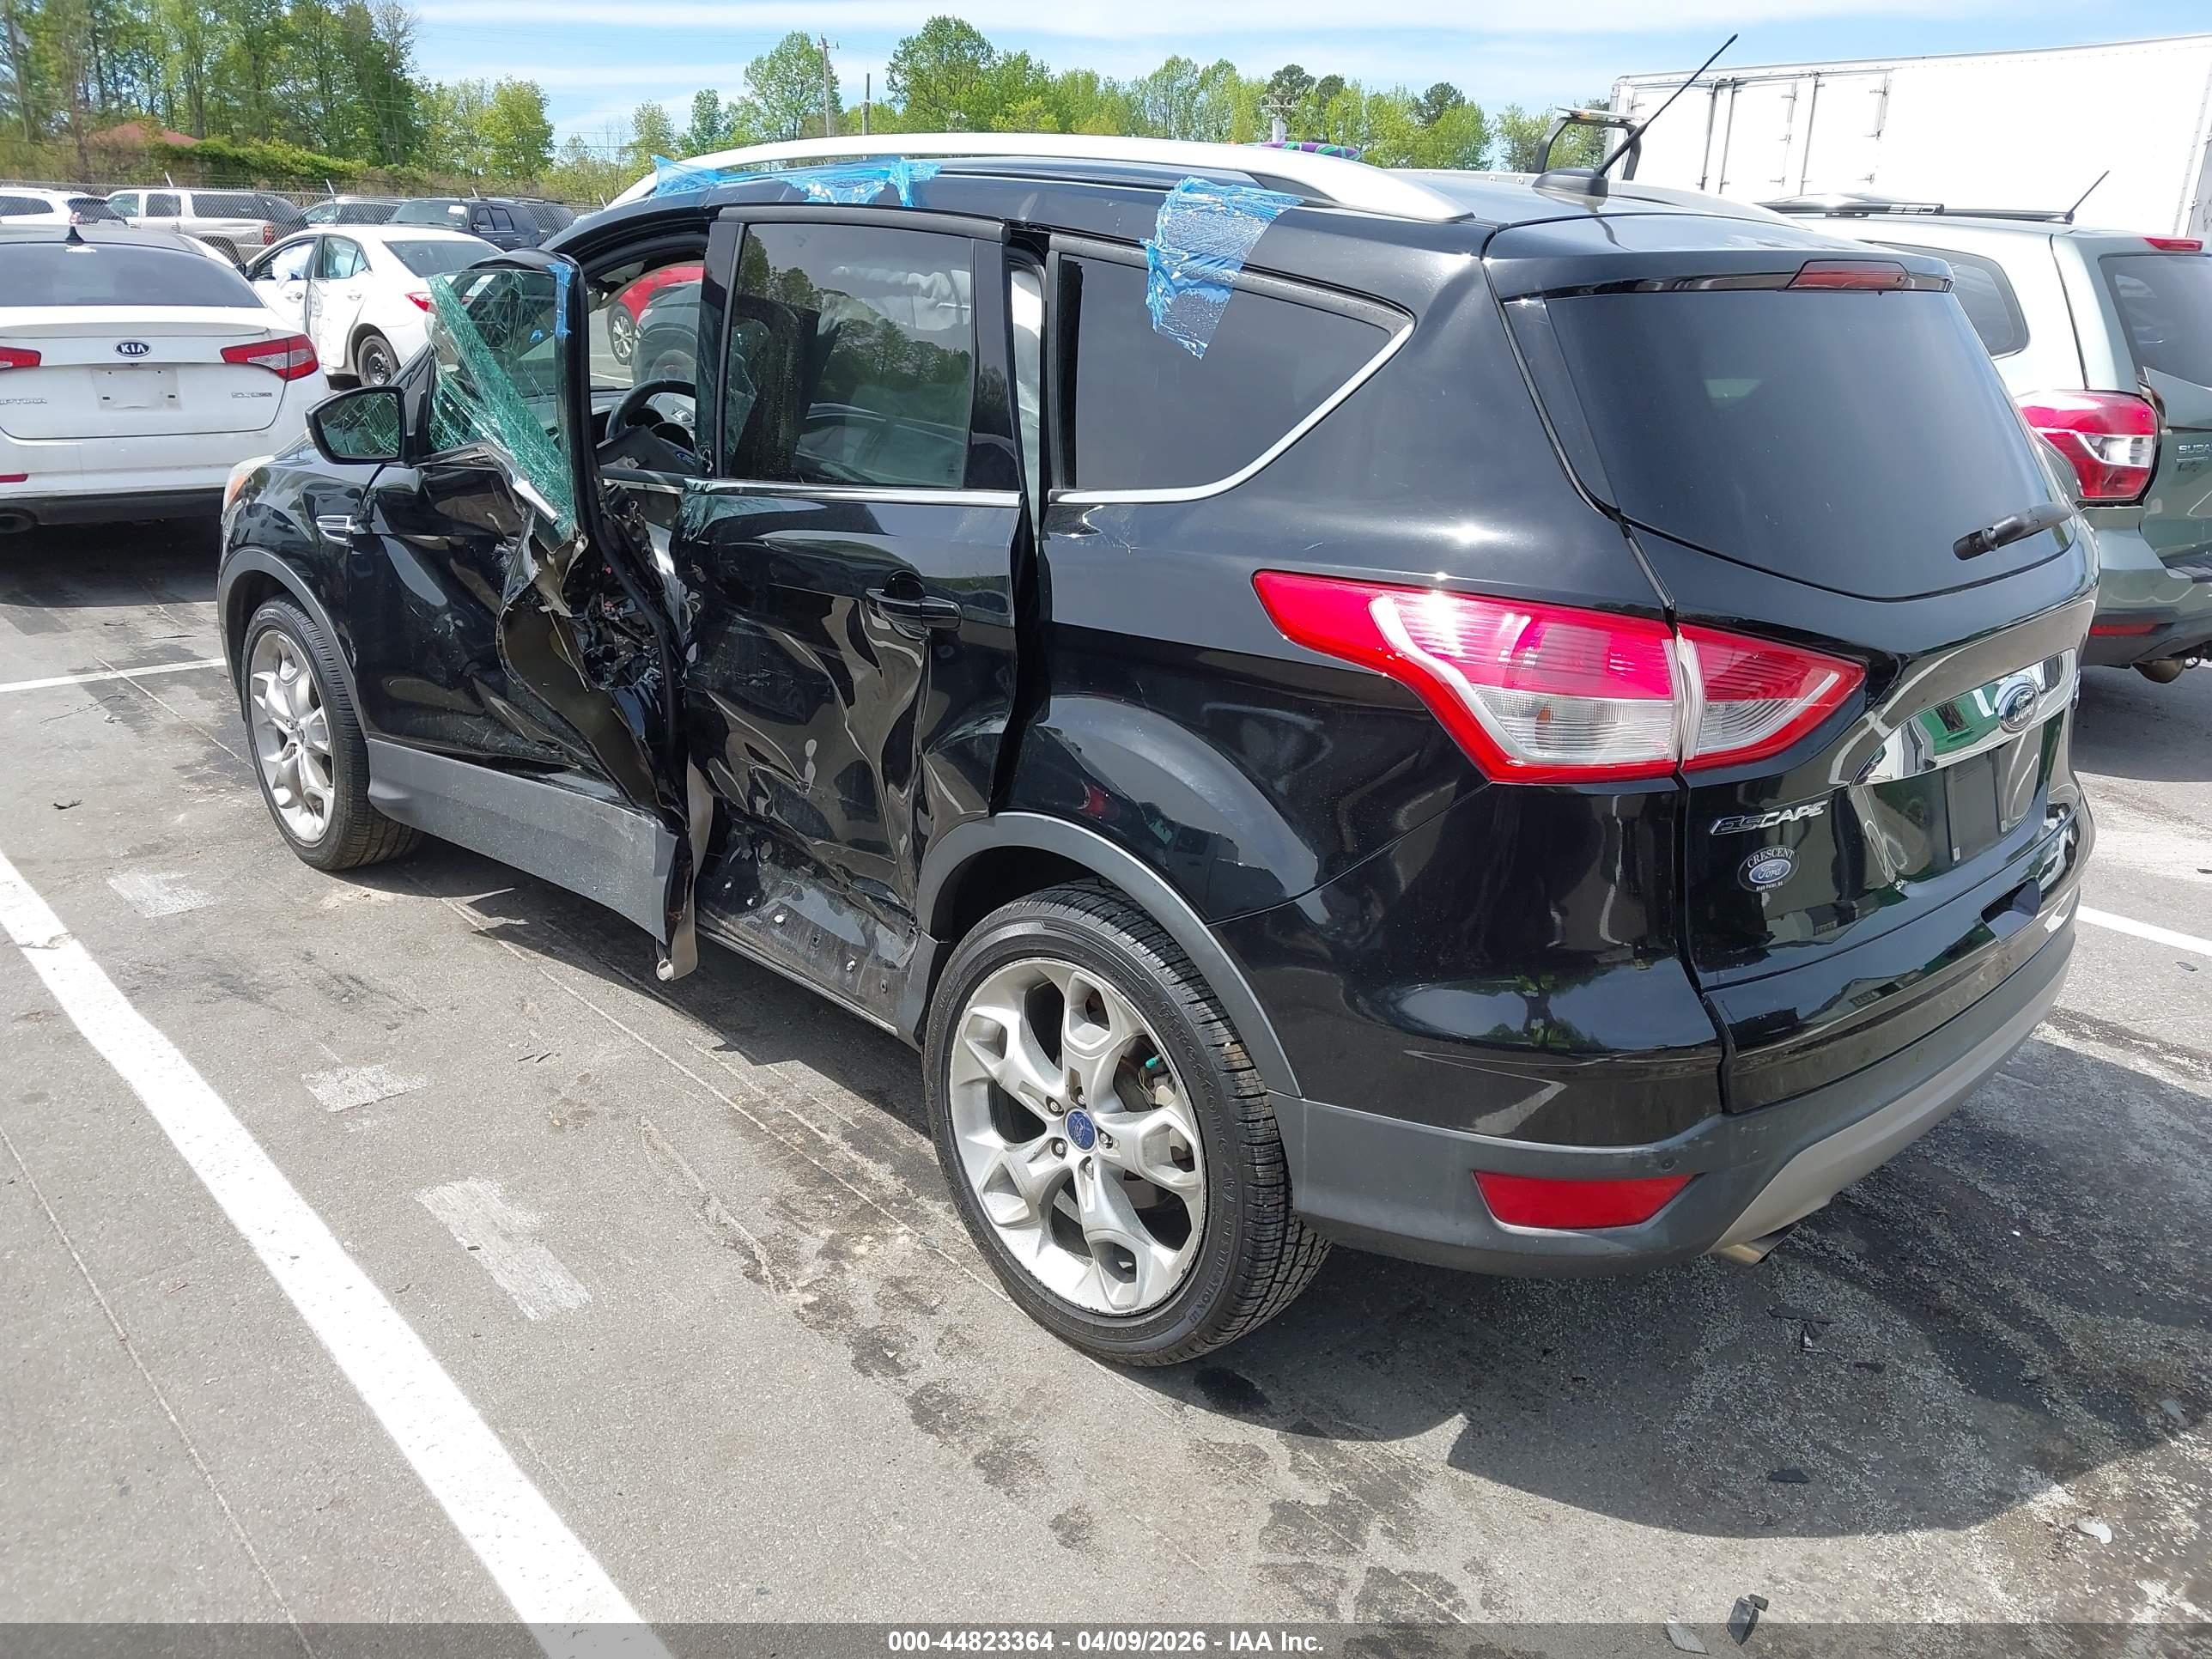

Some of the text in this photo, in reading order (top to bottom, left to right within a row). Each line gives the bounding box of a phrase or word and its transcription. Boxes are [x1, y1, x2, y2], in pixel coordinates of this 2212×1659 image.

[119, 343, 146, 353] KIA
[2179, 442, 2212, 454] SUBA
[2008, 690, 2036, 723] Ford
[1710, 799, 1829, 836] ESCAPE
[1747, 847, 1796, 869] CRESCENT
[1757, 864, 1784, 880] Ford
[1158, 1000, 1231, 1153] Firestone
